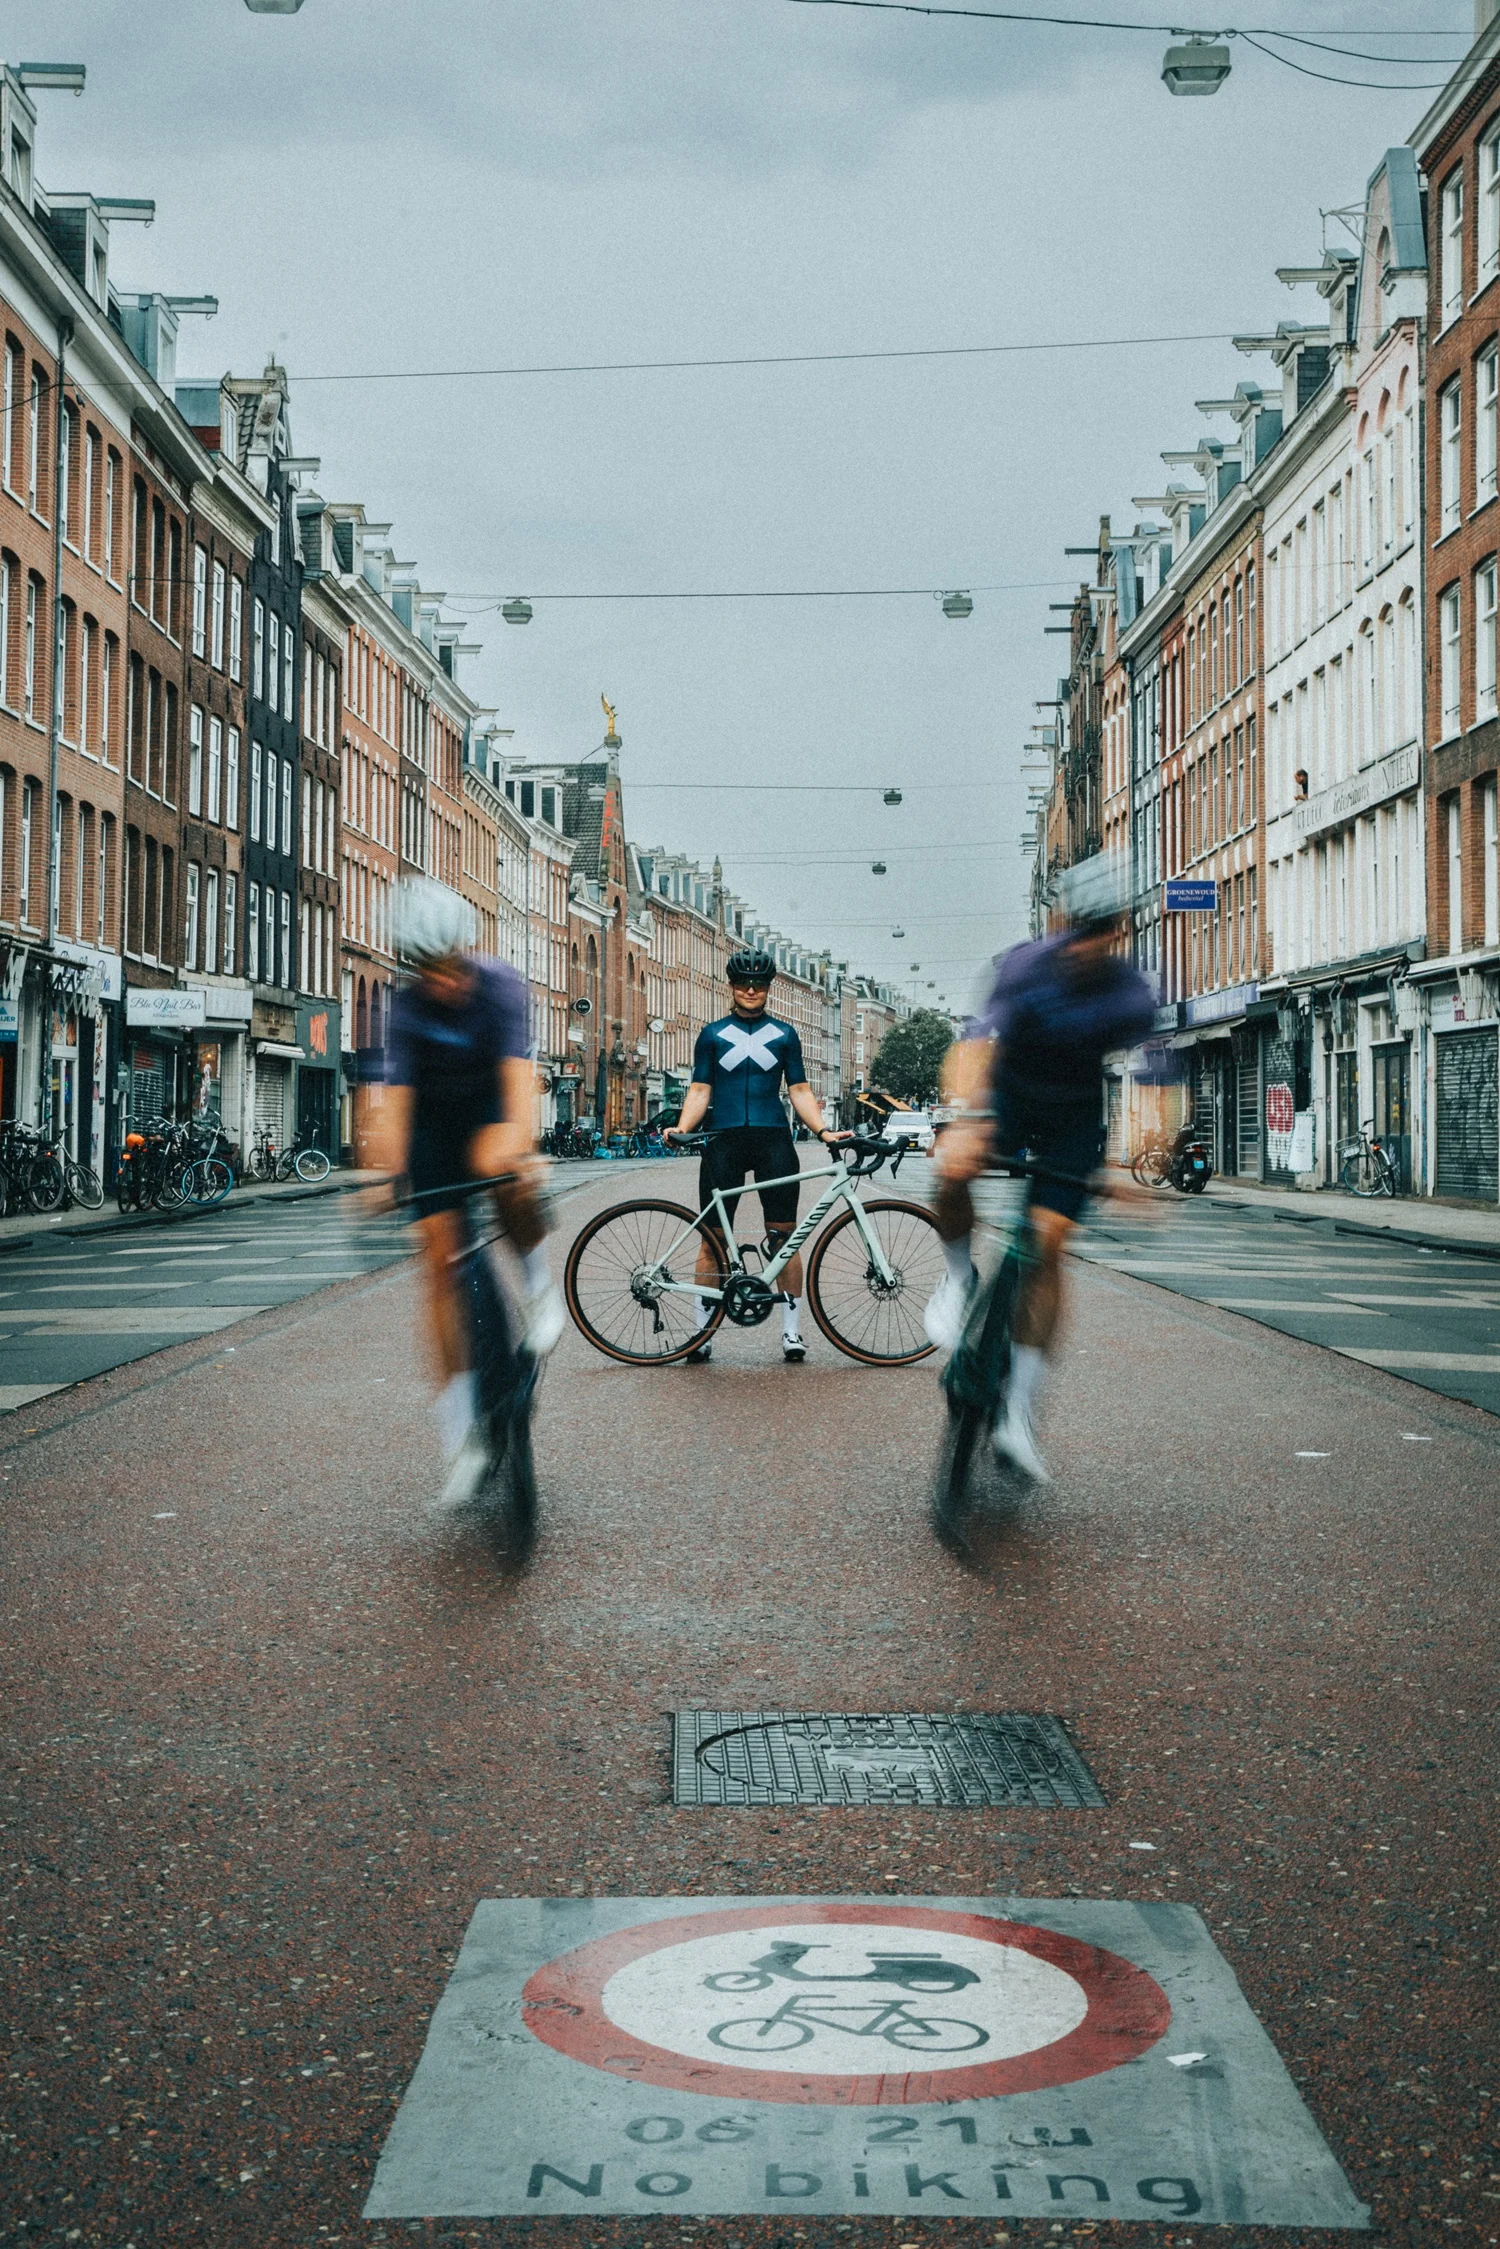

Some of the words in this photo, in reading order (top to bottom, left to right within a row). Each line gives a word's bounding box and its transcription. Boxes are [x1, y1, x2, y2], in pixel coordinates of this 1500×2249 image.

[153, 997, 178, 1013] Nail
[179, 999, 202, 1010] Bar
[779, 1202, 834, 1259] CANYON
[624, 2116, 755, 2144] 06
[865, 2115, 978, 2145] 21
[1033, 2127, 1094, 2147] u
[526, 2163, 693, 2198] No
[765, 2162, 1202, 2217] biking
